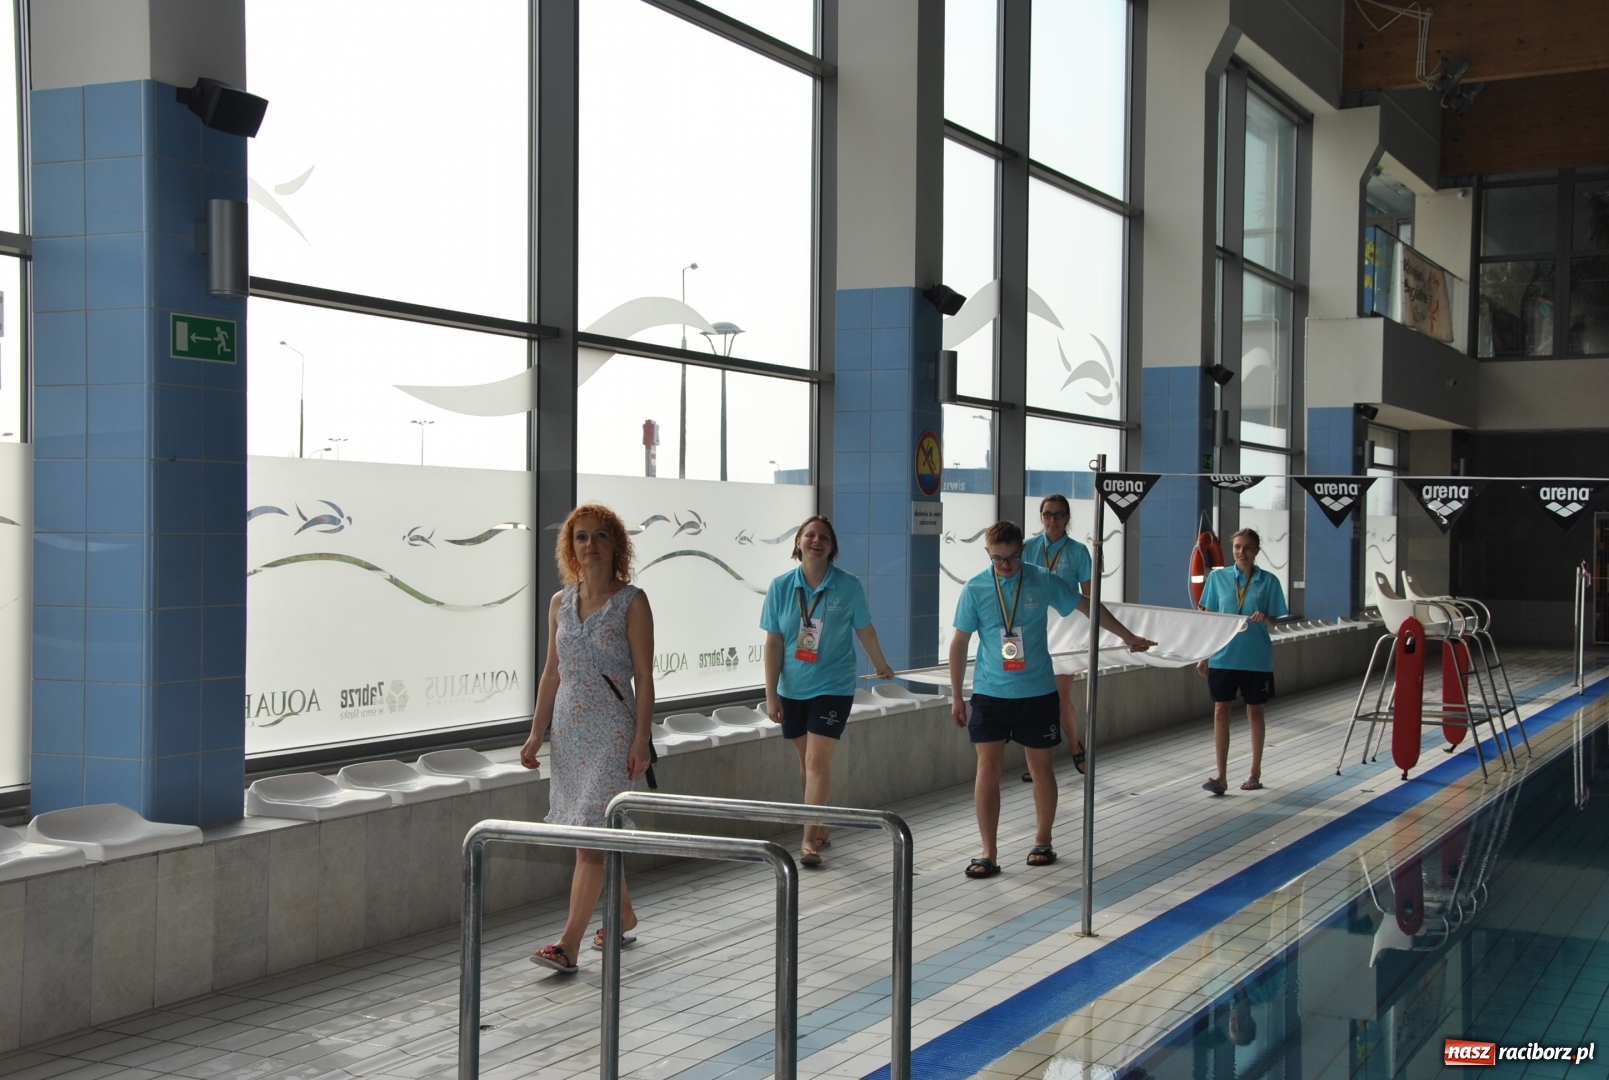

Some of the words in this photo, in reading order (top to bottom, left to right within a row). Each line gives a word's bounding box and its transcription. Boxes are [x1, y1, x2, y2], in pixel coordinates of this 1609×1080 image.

[1103, 477, 1143, 493] arena
[1314, 482, 1358, 496] arena
[1422, 485, 1469, 499] arena
[1540, 487, 1590, 501] arena
